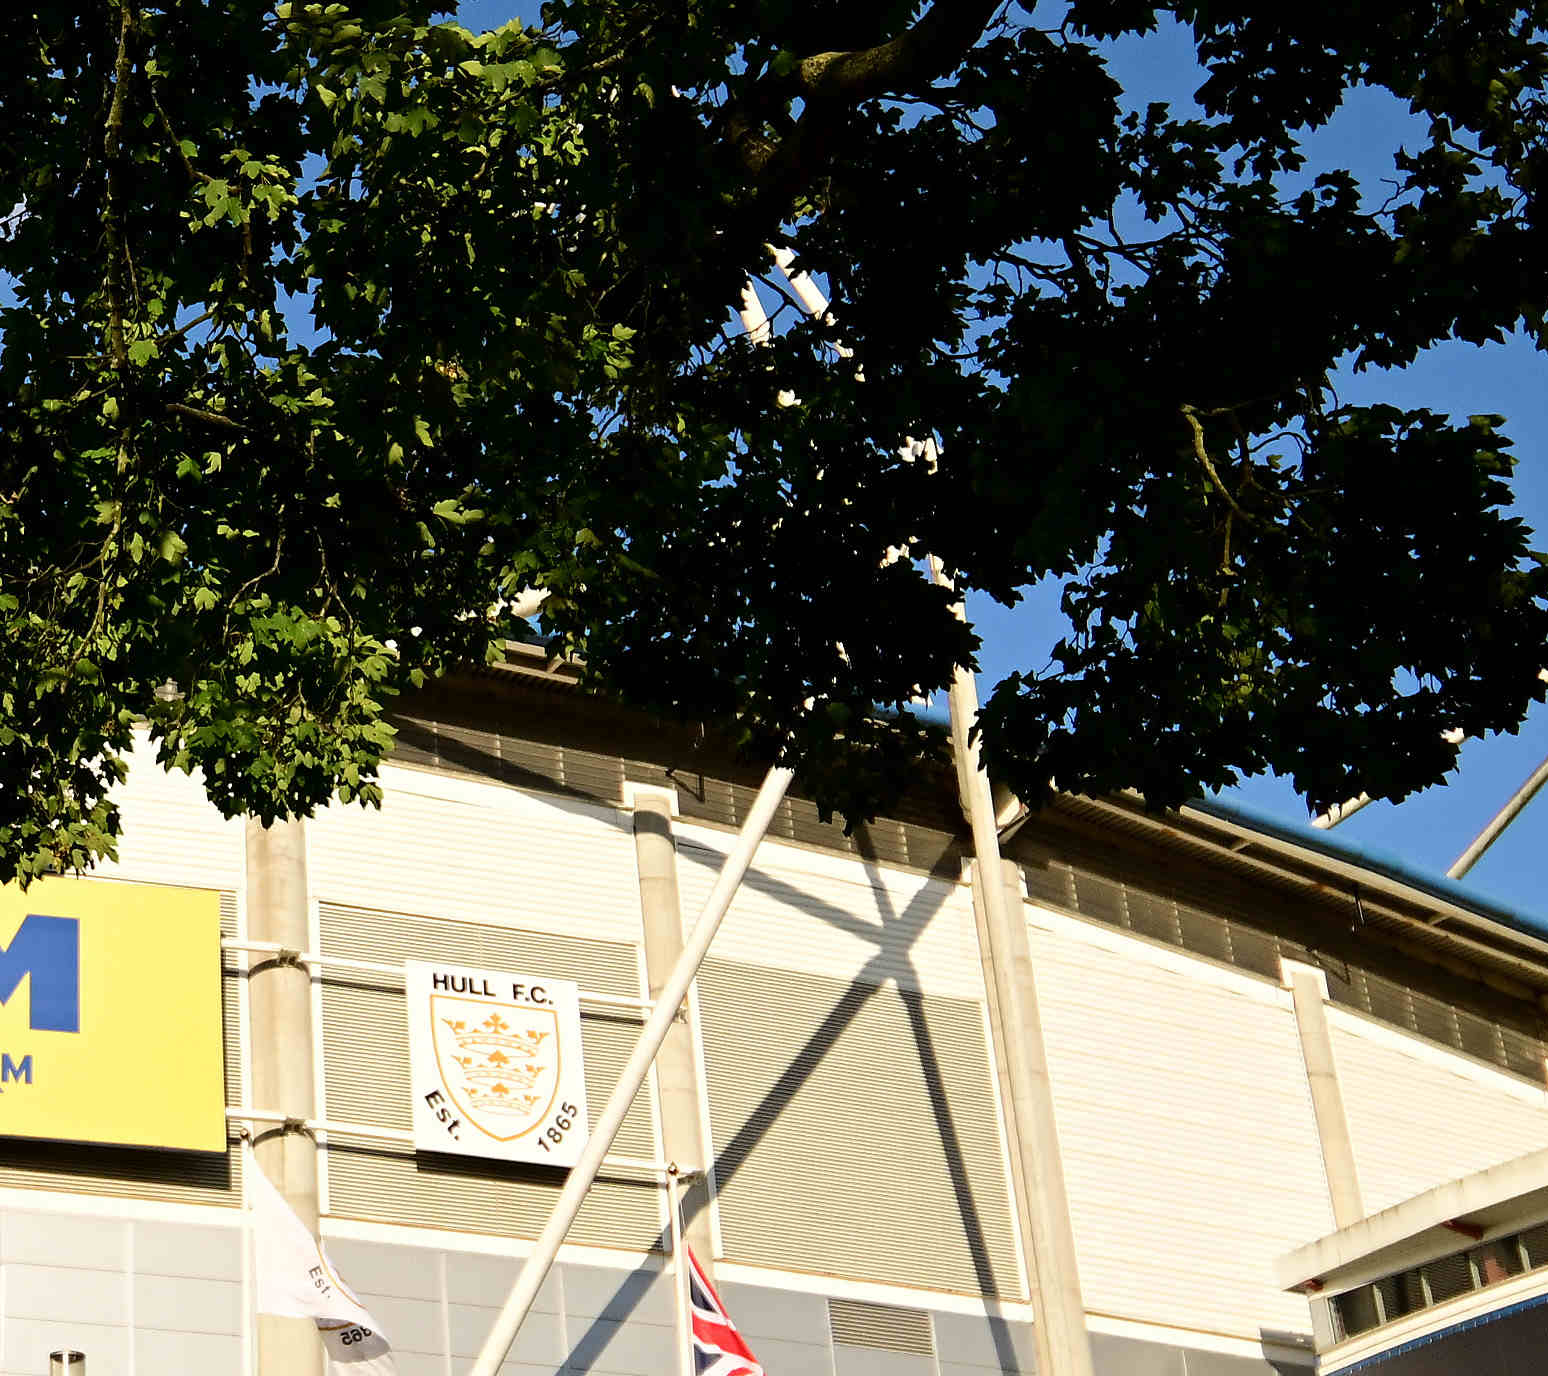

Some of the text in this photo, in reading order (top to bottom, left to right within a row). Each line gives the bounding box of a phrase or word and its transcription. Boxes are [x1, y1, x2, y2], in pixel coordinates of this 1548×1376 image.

[432, 972, 554, 1005] HULL F.C.
[424, 1088, 579, 1153] Est. 1865
[308, 1265, 333, 1300] Est.
